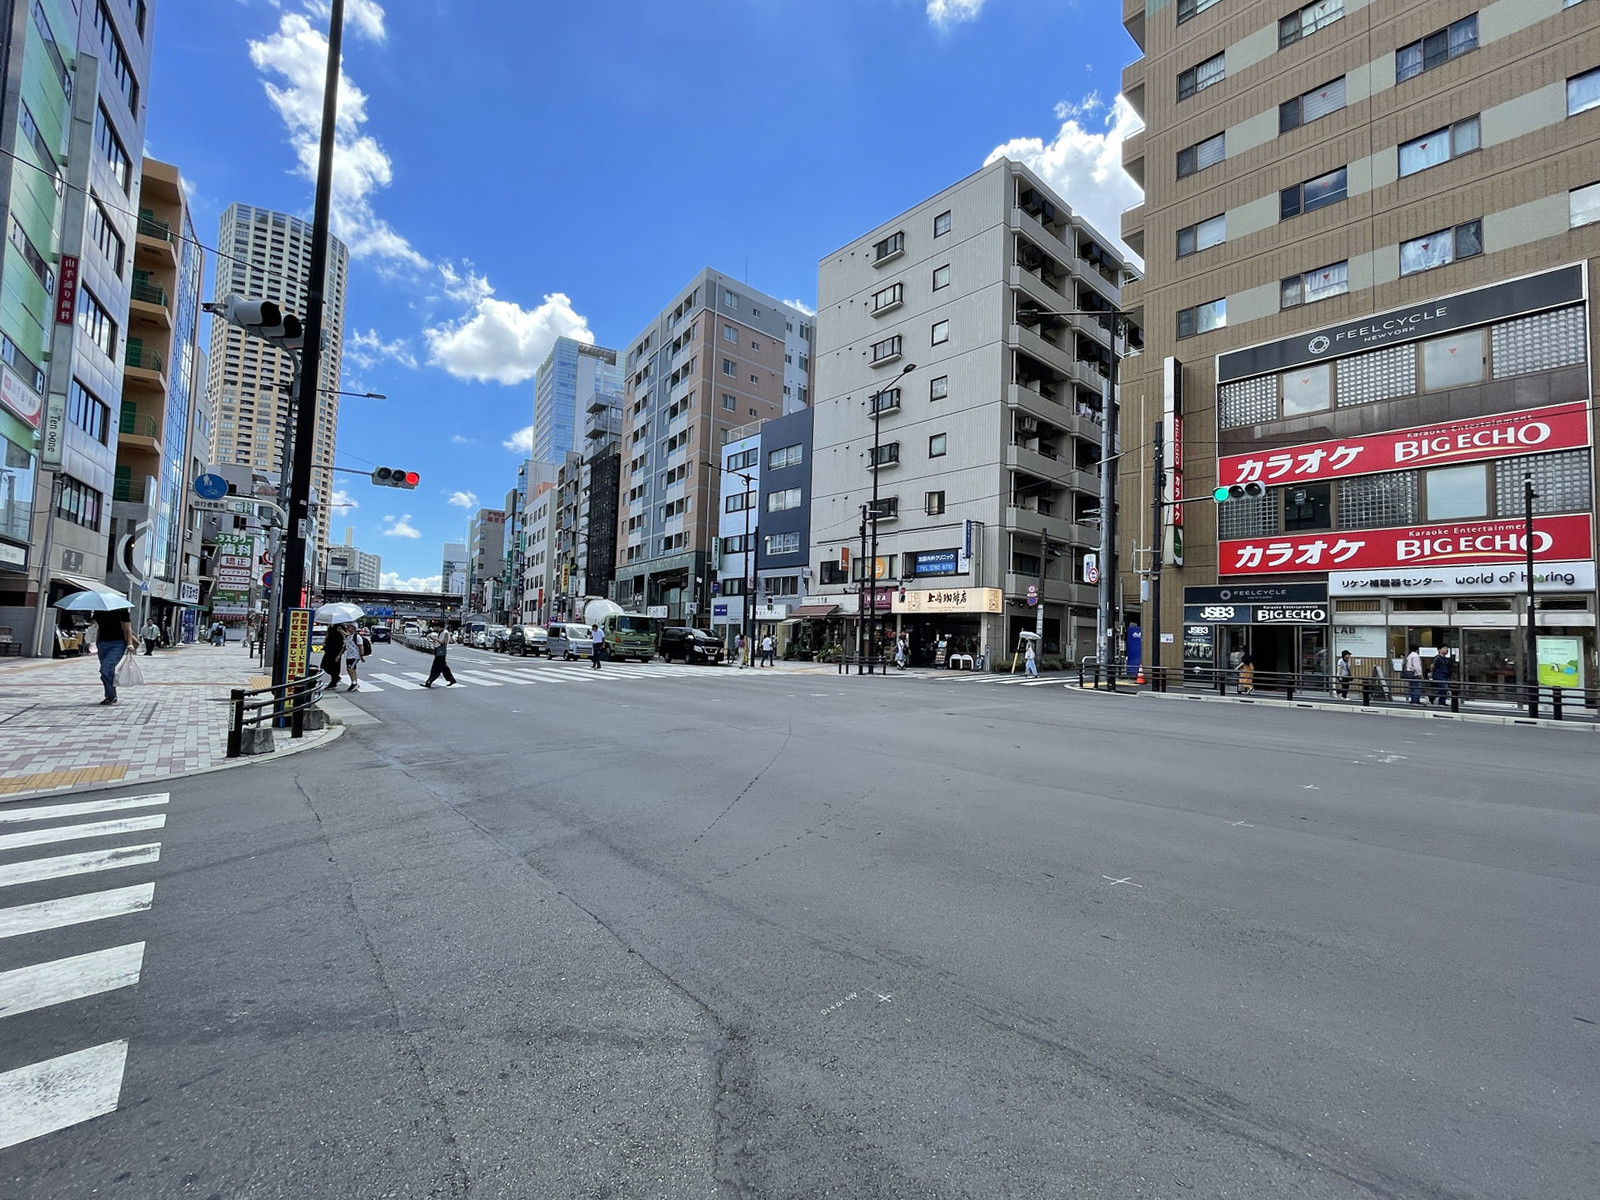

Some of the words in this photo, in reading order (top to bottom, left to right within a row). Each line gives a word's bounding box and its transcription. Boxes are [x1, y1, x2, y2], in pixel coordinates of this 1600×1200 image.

[60, 259, 75, 320] 山手通り歯科
[1336, 307, 1448, 341] FEELCYCLE
[1407, 428, 1448, 439] Karaoke
[1451, 414, 1533, 432] Entertainment
[1394, 437, 1451, 463] BIG
[1459, 422, 1552, 448] ECHO
[1234, 446, 1364, 483] カラオケ
[1408, 528, 1449, 537] Karaoke
[1453, 522, 1534, 535] Entertainmen
[215, 534, 253, 543] ラスタワー
[222, 543, 251, 556] 歯科
[1396, 538, 1452, 561] BIG
[1460, 531, 1553, 552] ECHO
[1234, 539, 1365, 569] カラオケ
[225, 557, 246, 565] 矯正
[1341, 578, 1443, 588] リケン補聴器センター
[1455, 572, 1494, 584] world
[1499, 571, 1516, 583] of
[1200, 606, 1235, 618] JSB3
[1257, 609, 1283, 621] BIG
[1285, 609, 1326, 621] ECHO
[1187, 626, 1209, 634] JSB3
[1334, 626, 1356, 634] LAB
